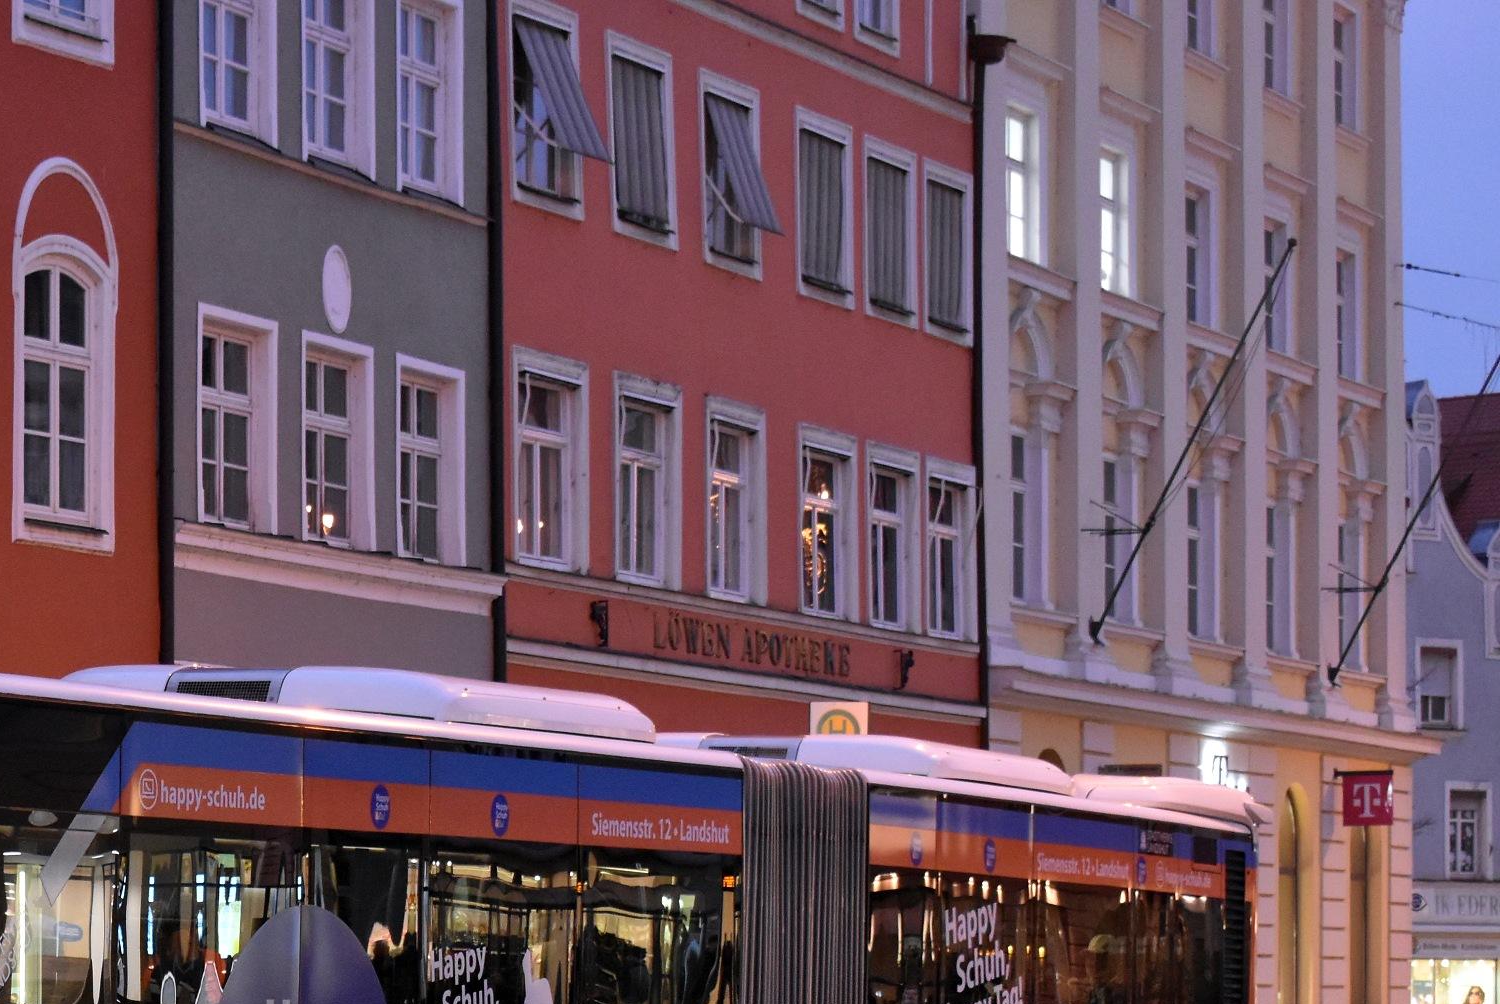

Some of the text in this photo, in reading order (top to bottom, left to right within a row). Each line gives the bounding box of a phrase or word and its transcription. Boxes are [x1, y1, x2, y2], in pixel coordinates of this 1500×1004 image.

[652, 611, 851, 677] LÖWEN APOTHEKE
[160, 783, 265, 812] happy-schuh.de
[1353, 783, 1381, 818] T
[591, 811, 730, 846] Siemensstr. 12 Landshut
[1037, 851, 1080, 874] Siemensstr.
[1082, 858, 1091, 875] 12
[1095, 862, 1129, 879] Landshut
[945, 903, 998, 949] Happy
[431, 946, 486, 984] Happy
[956, 940, 1010, 993] Schuh,
